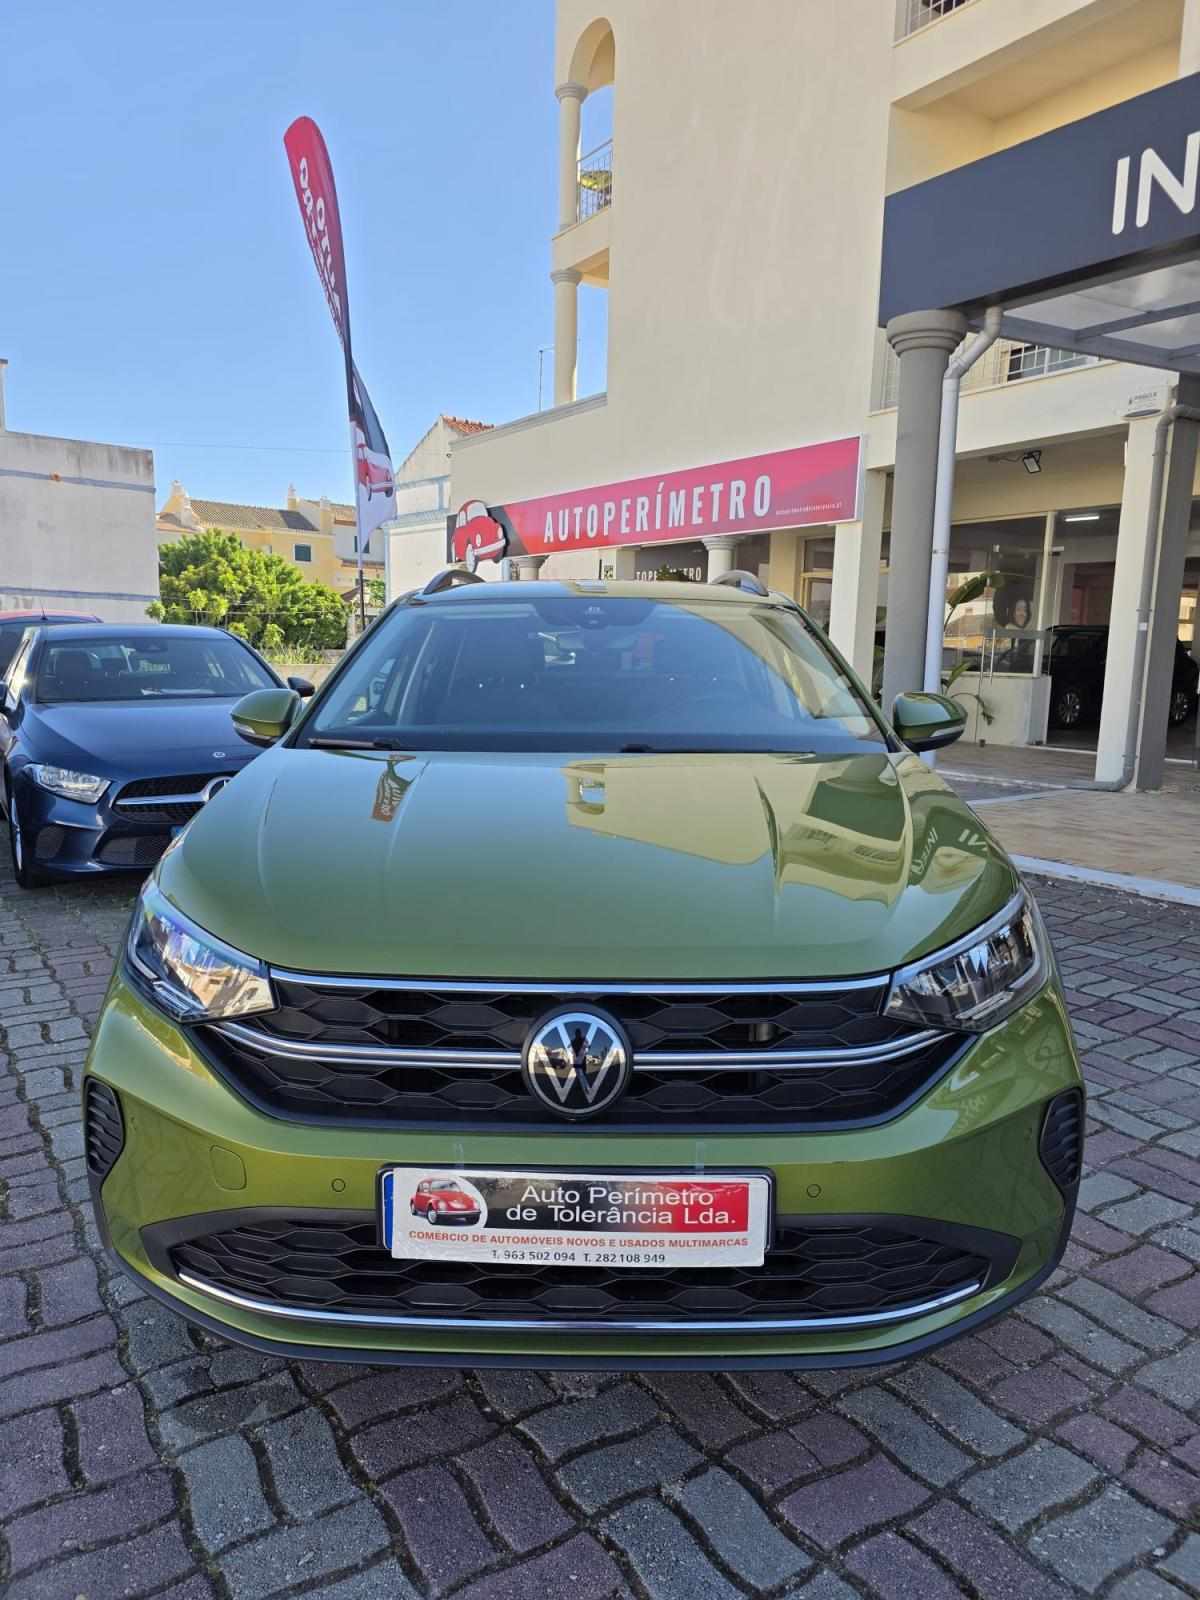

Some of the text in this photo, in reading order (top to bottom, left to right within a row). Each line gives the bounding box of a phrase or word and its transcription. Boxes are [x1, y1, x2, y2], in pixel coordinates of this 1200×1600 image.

[543, 474, 771, 544] AUTOPERÍMETRO
[529, 1012, 626, 1106] VW
[521, 1185, 714, 1206] Auto Perímetro
[506, 1204, 736, 1224] de Tolerância Lda.
[472, 1234, 487, 1243] DE
[566, 1237, 606, 1247] NOVOS
[609, 1238, 617, 1248] E
[619, 1239, 665, 1248] USADOS
[668, 1238, 749, 1248] MULTIMARCAS
[503, 1250, 525, 1260] 963
[527, 1251, 550, 1261] 502
[553, 1252, 576, 1262] 094
[595, 1253, 617, 1263] 282
